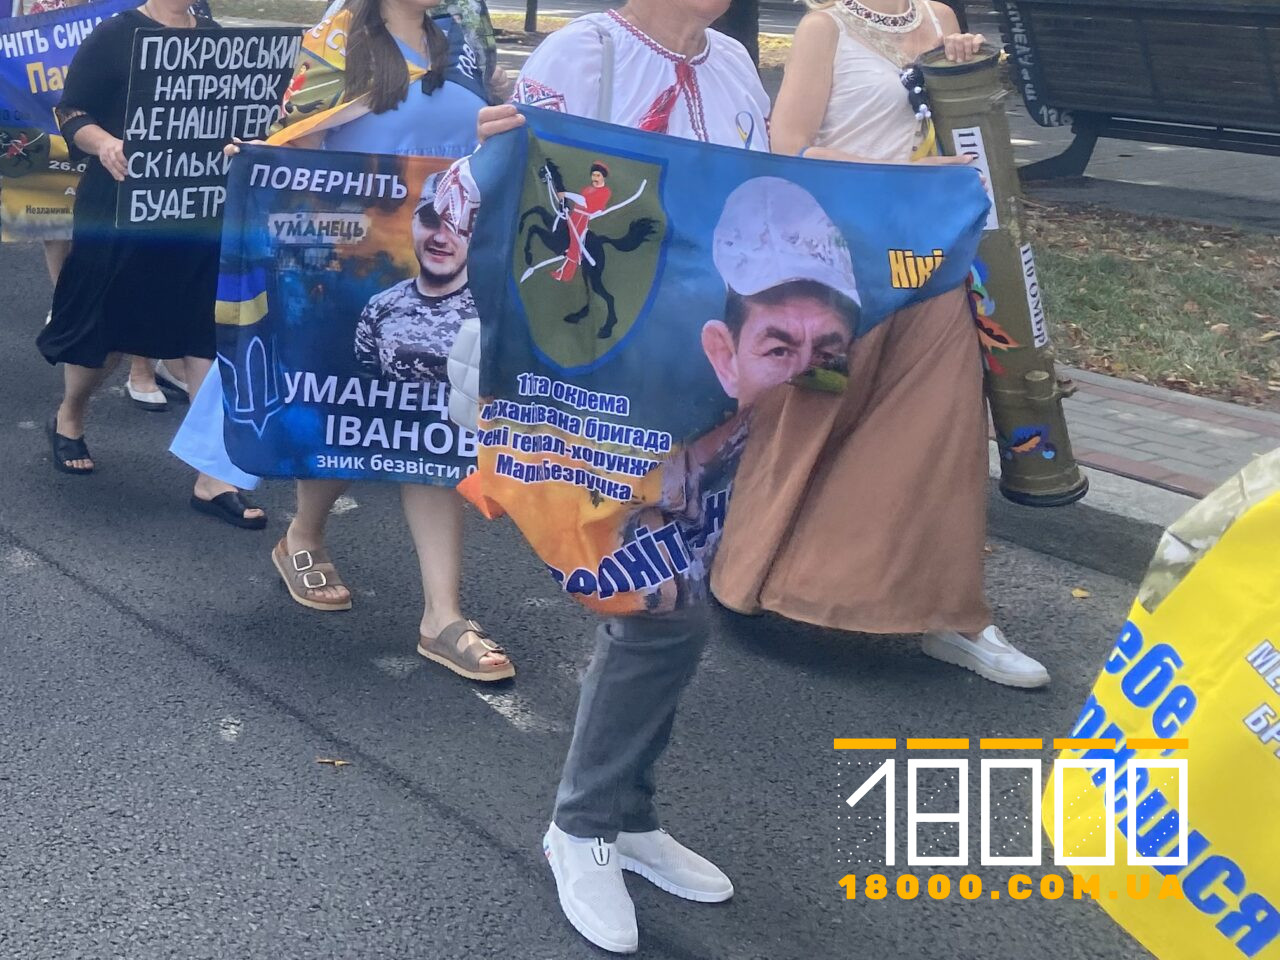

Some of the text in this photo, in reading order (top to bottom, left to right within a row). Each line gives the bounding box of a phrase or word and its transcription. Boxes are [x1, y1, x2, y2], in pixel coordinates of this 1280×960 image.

[154, 73, 282, 102] НАПРЯМОК
[125, 106, 165, 141] ДЕ
[48, 160, 87, 173] 26.0
[249, 164, 408, 200] ПОВЕРНІТЬ
[284, 371, 450, 421] УМАНЕЦ
[551, 381, 630, 416] окрема
[584, 418, 672, 453] бригада
[317, 454, 366, 470] зник
[370, 454, 460, 480] безвісти
[1242, 702, 1280, 759] БР
